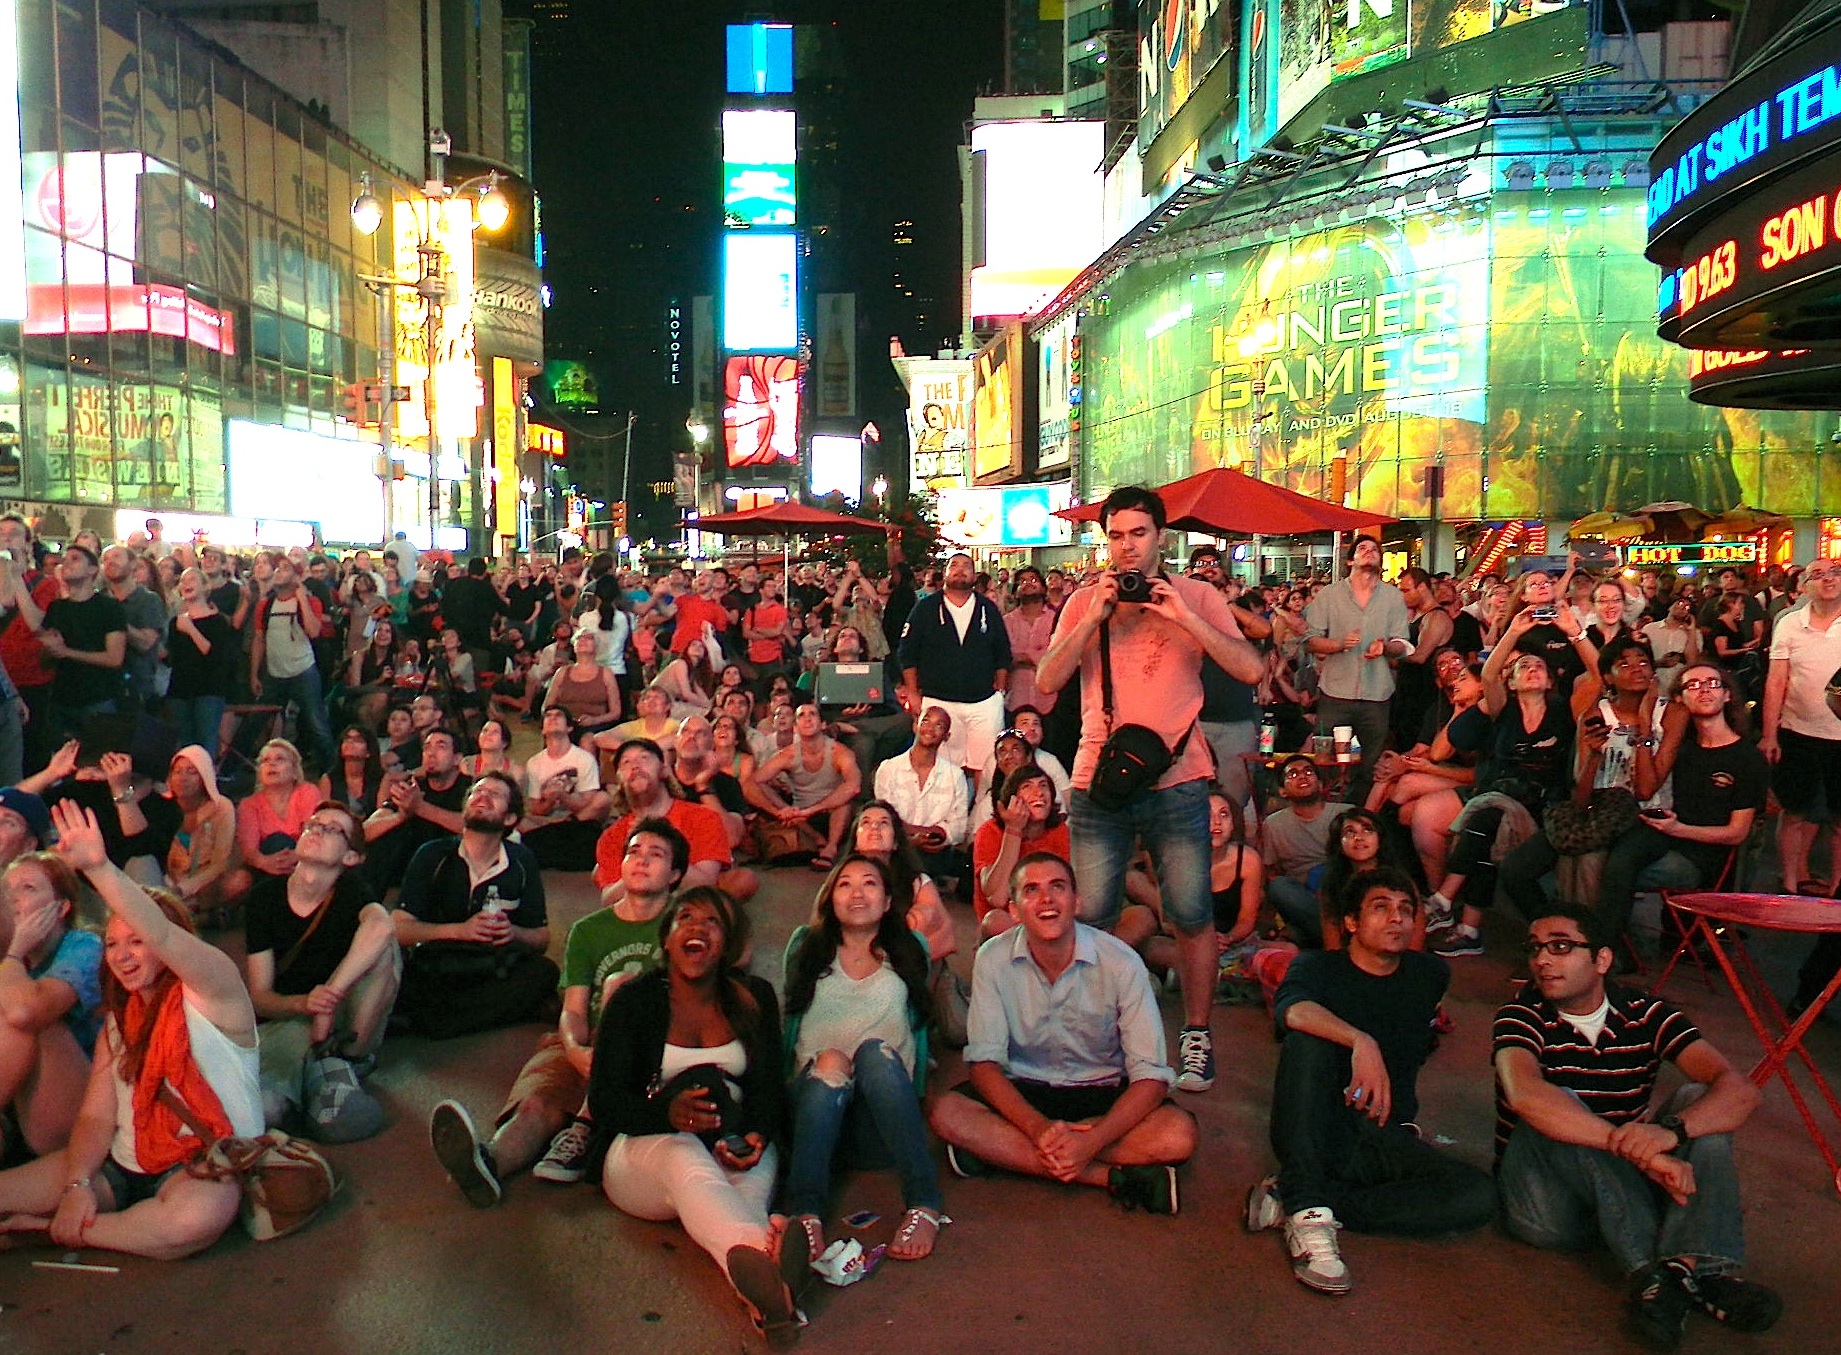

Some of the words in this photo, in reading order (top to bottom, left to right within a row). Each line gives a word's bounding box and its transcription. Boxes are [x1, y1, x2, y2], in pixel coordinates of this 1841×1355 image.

[506, 51, 526, 153] TIMES
[1674, 142, 1703, 203] AT
[1705, 100, 1770, 181] SIKH
[1761, 195, 1827, 269] SON
[1297, 275, 1354, 304] THE
[669, 308, 681, 385] NOVOTEL
[1208, 334, 1461, 411] GAMES
[924, 382, 953, 401] THE
[1201, 428, 1222, 441] ON
[1288, 416, 1321, 432] AND
[1325, 413, 1356, 428] DVD
[1630, 547, 1682, 564] HOT
